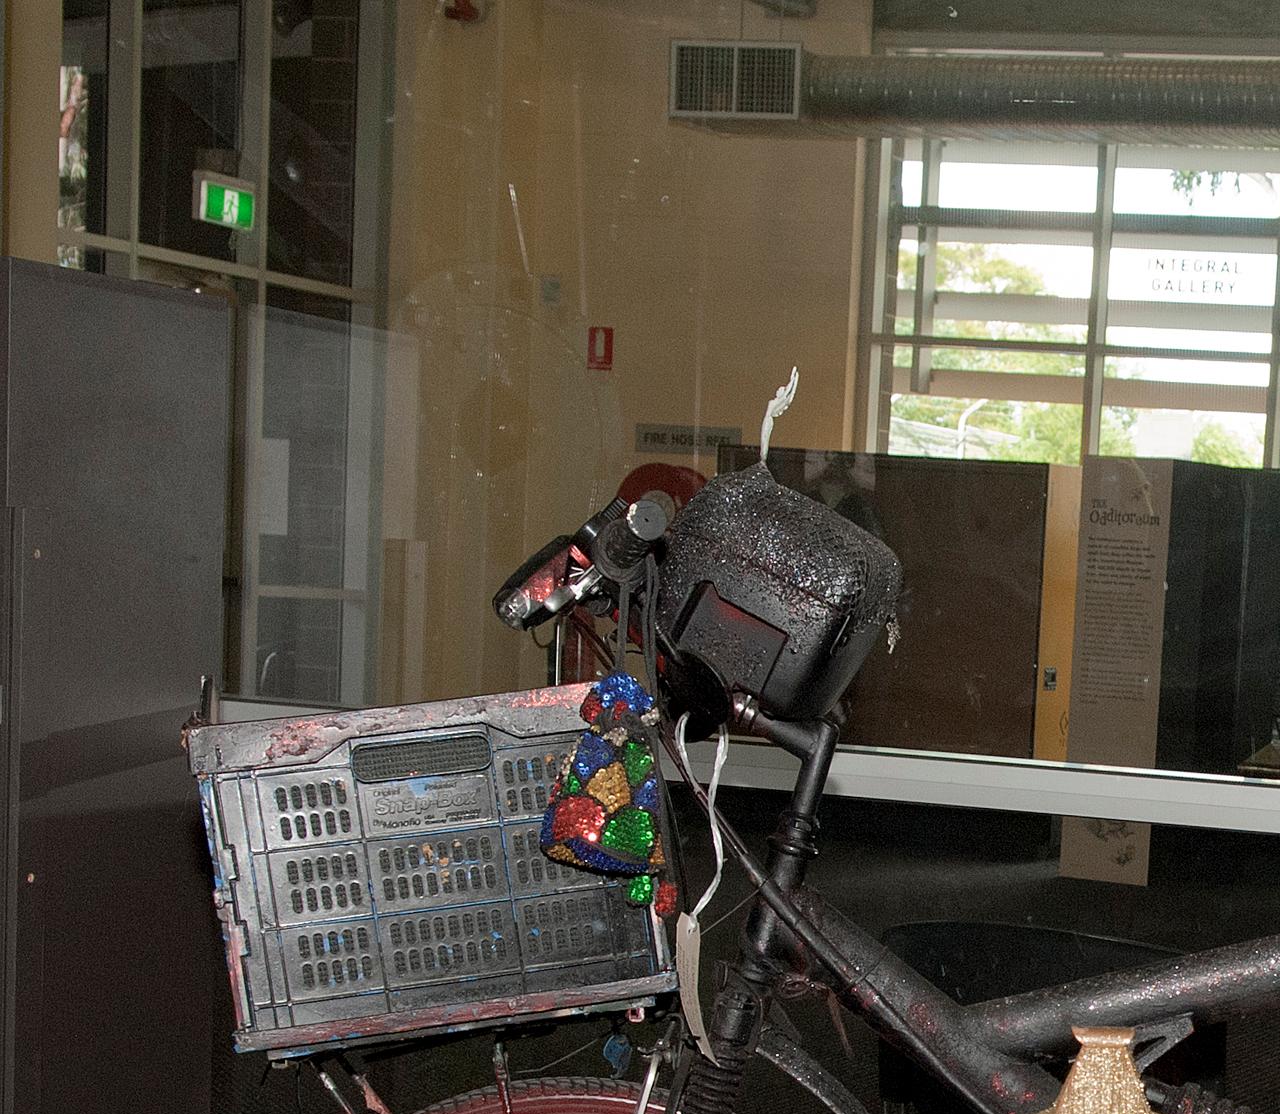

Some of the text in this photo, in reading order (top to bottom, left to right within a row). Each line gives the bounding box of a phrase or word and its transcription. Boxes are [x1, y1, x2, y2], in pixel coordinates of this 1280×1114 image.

[1147, 258, 1242, 274] INTEGRAL
[1151, 279, 1235, 293] GALLERY
[643, 432, 667, 445] FIRE
[375, 790, 477, 815] Snap-Box
